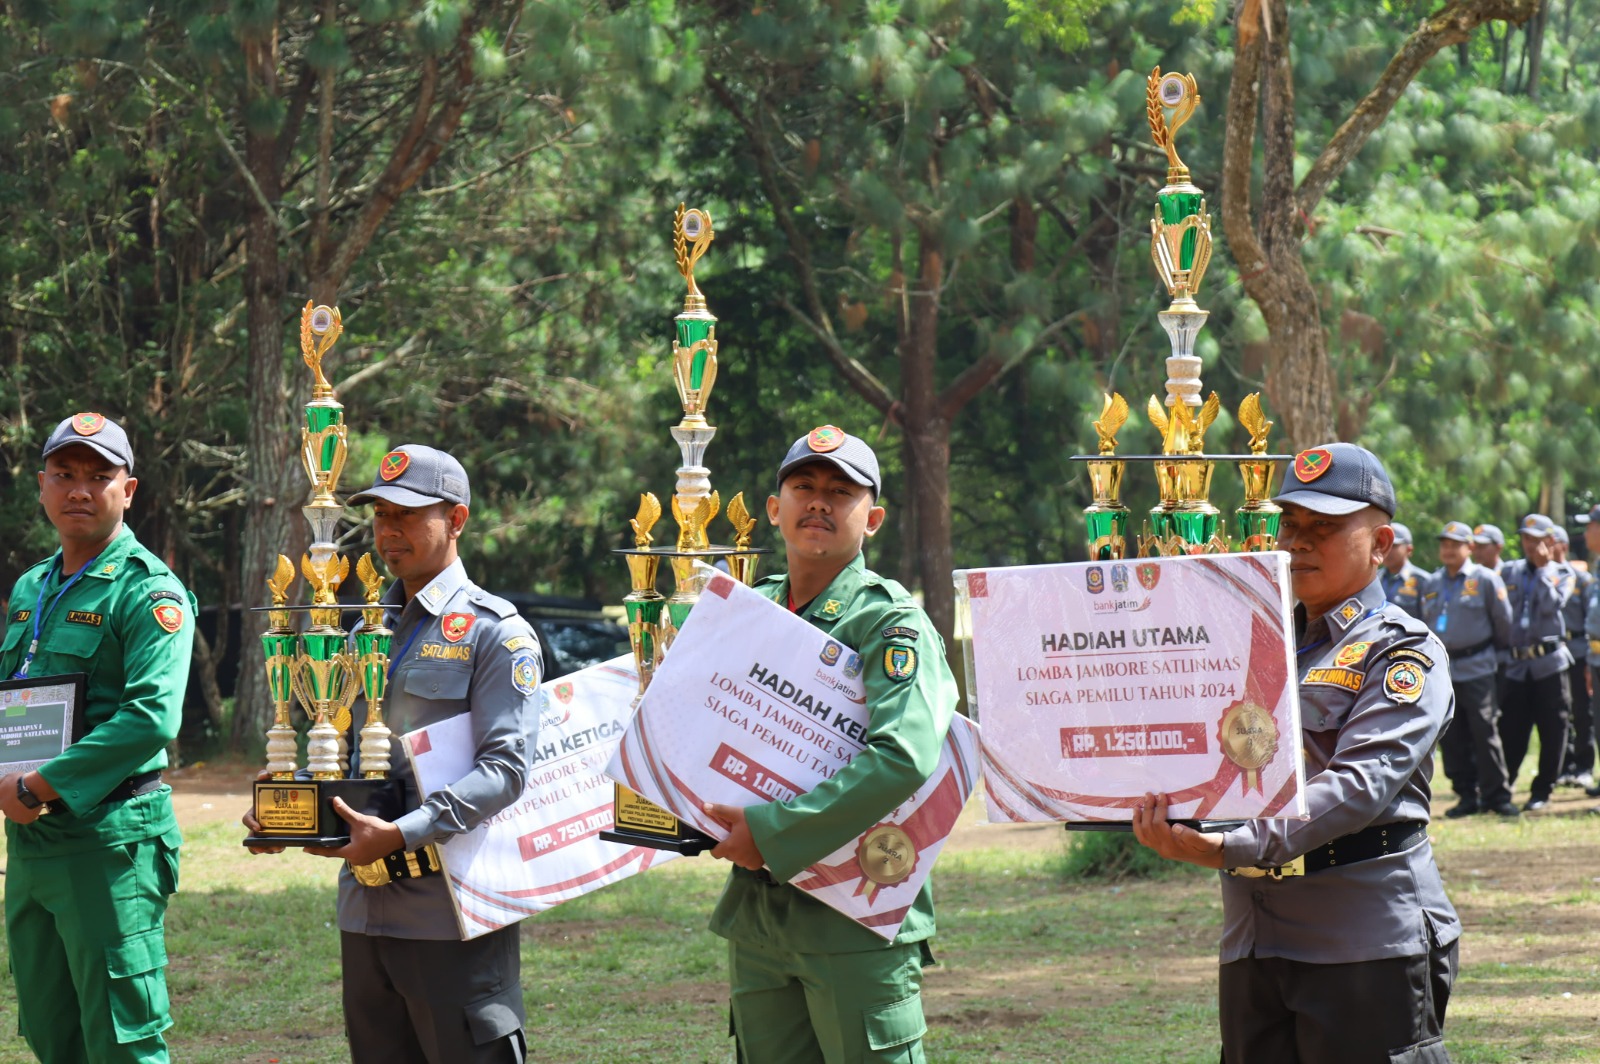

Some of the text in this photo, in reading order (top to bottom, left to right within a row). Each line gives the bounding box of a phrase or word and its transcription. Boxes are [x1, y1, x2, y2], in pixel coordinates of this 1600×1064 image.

[1094, 600, 1139, 611] bankjatim
[420, 643, 470, 661] SATLINMAS
[1041, 625, 1211, 652] HADIAH UTAMA
[1017, 656, 1241, 682] LOMBA JAMBORE SATLINMAS
[1305, 669, 1362, 690] SATLINMAS
[748, 662, 832, 722] HADIAH
[815, 668, 857, 698] bankjatim
[1025, 682, 1236, 706] SIAGA PEMILU TAHUN 2024
[541, 715, 561, 729] jatim
[710, 671, 836, 754] LOMBA JAMBORE
[559, 719, 624, 754] KETIGA
[704, 695, 749, 731] SIAGA
[751, 722, 810, 764] PEMILU
[1073, 729, 1196, 753] RP. 1.250.000,-
[1236, 726, 1263, 735] JUARA
[526, 761, 580, 792] AMBORE
[721, 754, 749, 782] RP.
[522, 786, 572, 814] PEMILU
[532, 808, 614, 853] RP. 750.000
[877, 842, 902, 860] JUARA
